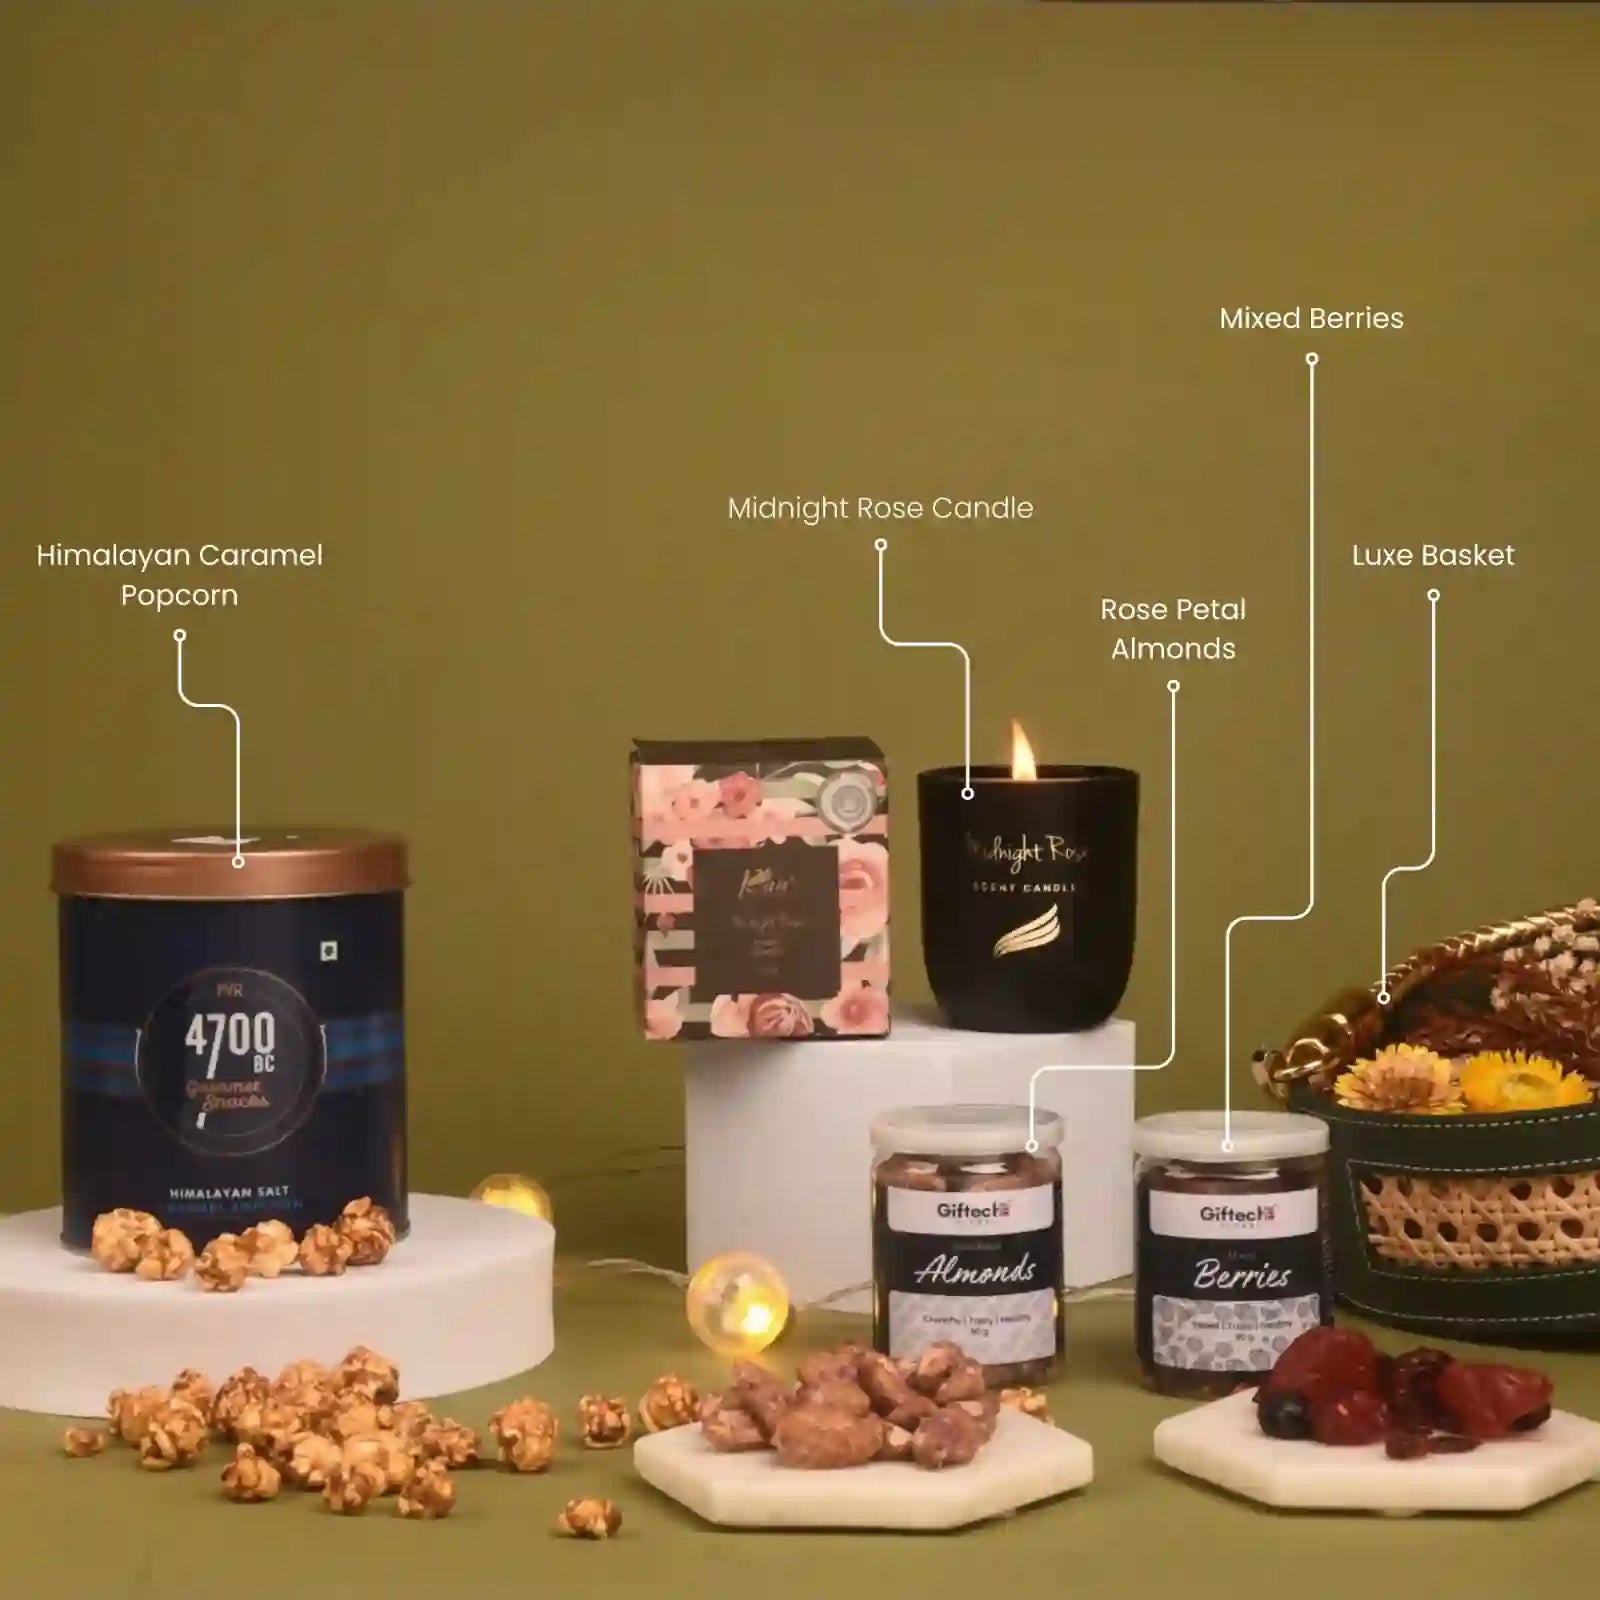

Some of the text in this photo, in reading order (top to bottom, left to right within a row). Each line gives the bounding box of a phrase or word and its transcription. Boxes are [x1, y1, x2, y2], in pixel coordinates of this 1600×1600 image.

[966, 831, 1044, 874] dnight
[185, 1011, 276, 1080] 4700
[253, 1054, 275, 1074] BC
[169, 1185, 290, 1200] HIMALAYAN SALT
[913, 1251, 1038, 1285] Almonds
[1193, 1257, 1293, 1290] Berries
